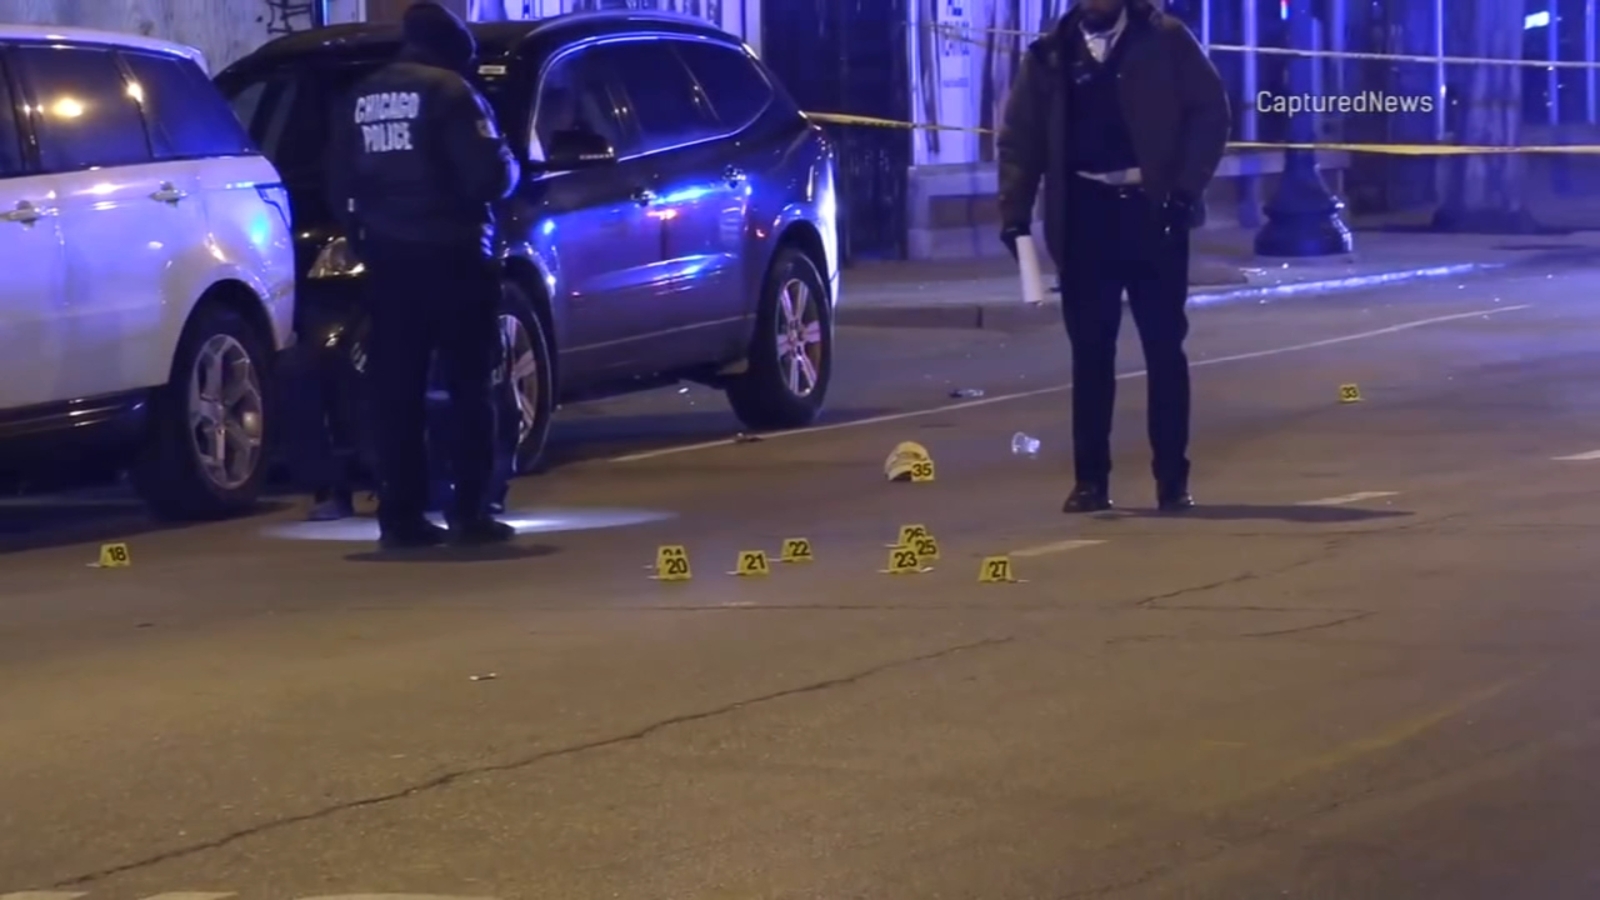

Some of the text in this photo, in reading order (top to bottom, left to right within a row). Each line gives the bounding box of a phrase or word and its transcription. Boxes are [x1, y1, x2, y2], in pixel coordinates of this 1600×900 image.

[355, 92, 420, 124] CHICAGO
[361, 122, 414, 153] POLICE
[1343, 386, 1358, 399] 33
[912, 463, 932, 477] 35
[107, 546, 126, 561] 18
[789, 541, 810, 557] 22
[916, 540, 936, 555] 25
[666, 558, 687, 574] 20
[745, 554, 765, 570] 21
[894, 552, 917, 568] 23
[989, 561, 1007, 578] 27
